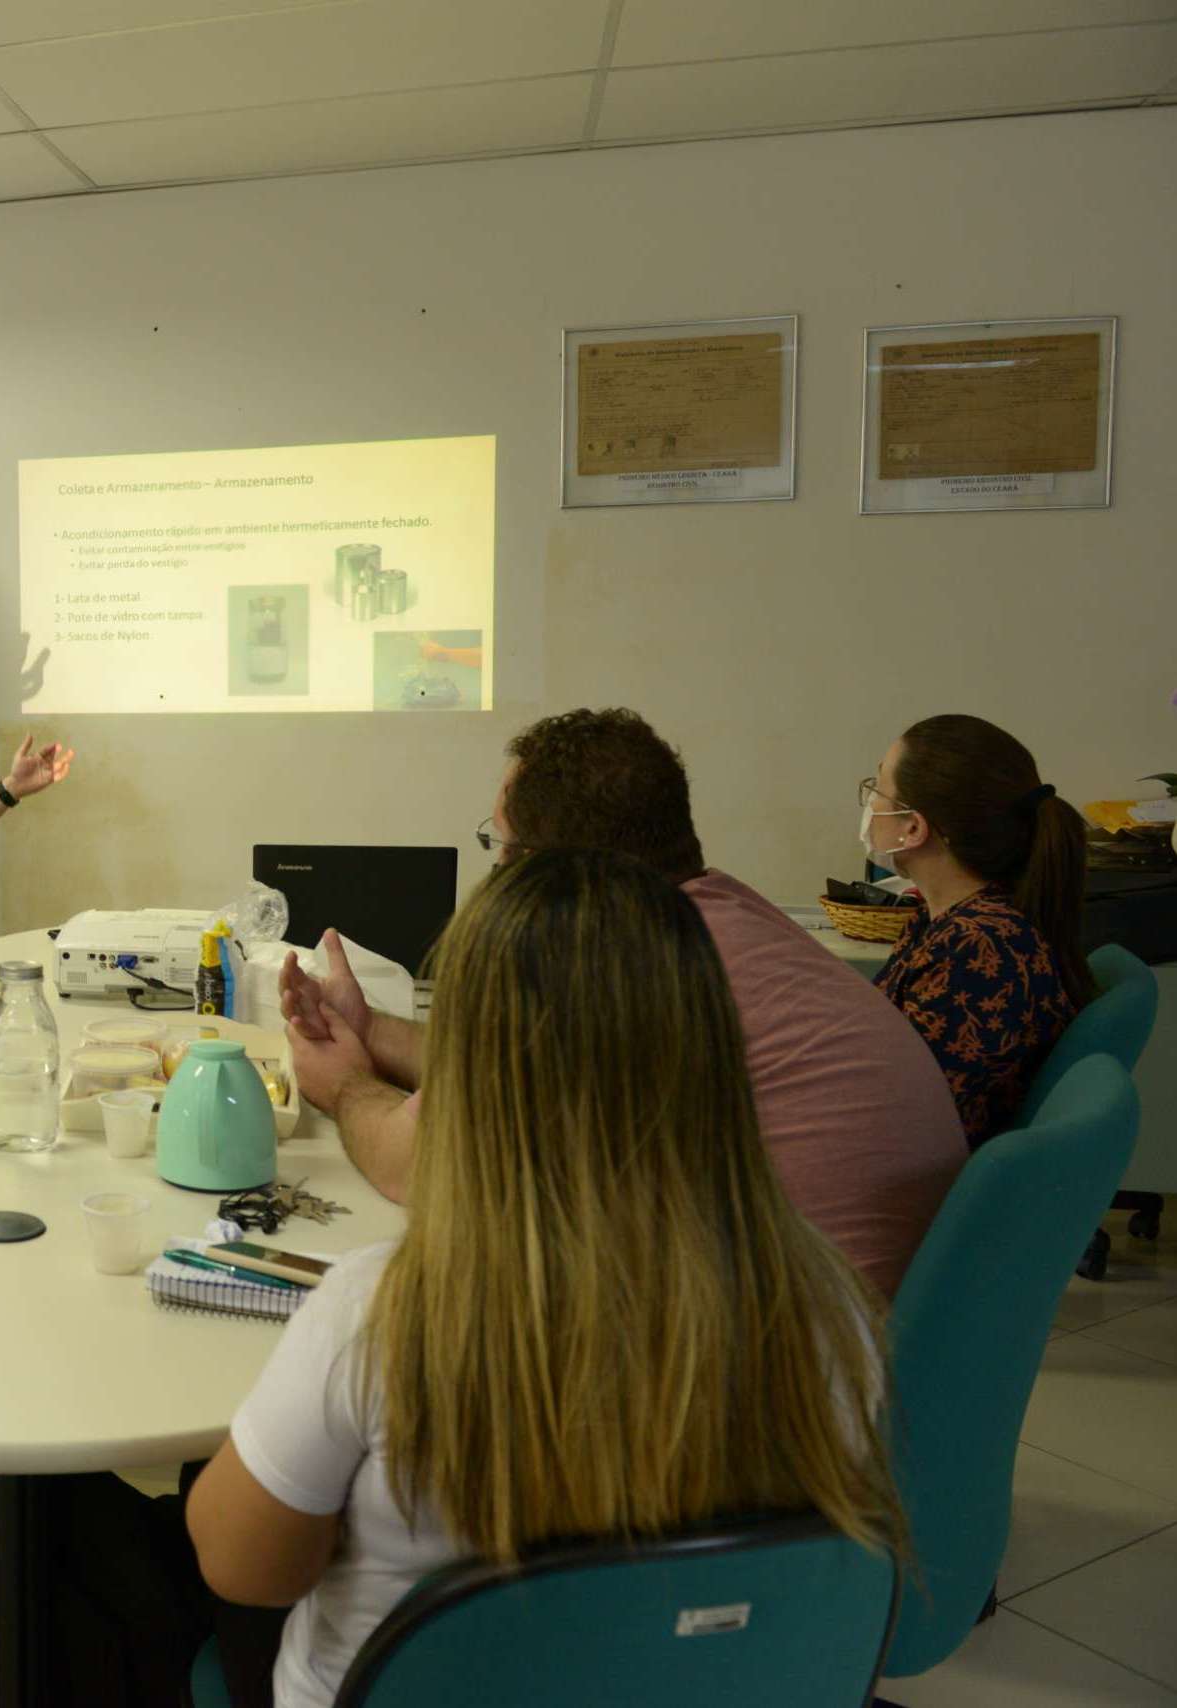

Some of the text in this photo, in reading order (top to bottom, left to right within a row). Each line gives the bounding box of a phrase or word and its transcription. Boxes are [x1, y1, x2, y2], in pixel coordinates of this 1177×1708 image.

[58, 484, 96, 496] Coleta
[97, 486, 104, 494] e
[106, 480, 202, 494] Armazenamento
[214, 474, 314, 488] Armazenamento
[61, 526, 164, 540] Acondicionamento
[205, 527, 223, 536] em
[225, 522, 280, 535] ambiente
[382, 516, 432, 529] fechado.
[68, 593, 90, 603] Lata
[92, 592, 107, 602] de
[68, 612, 93, 623] Pote
[95, 612, 109, 622] de
[111, 610, 140, 621] vidro
[141, 611, 166, 621] com
[68, 631, 98, 641] Sacos
[100, 630, 115, 641] de
